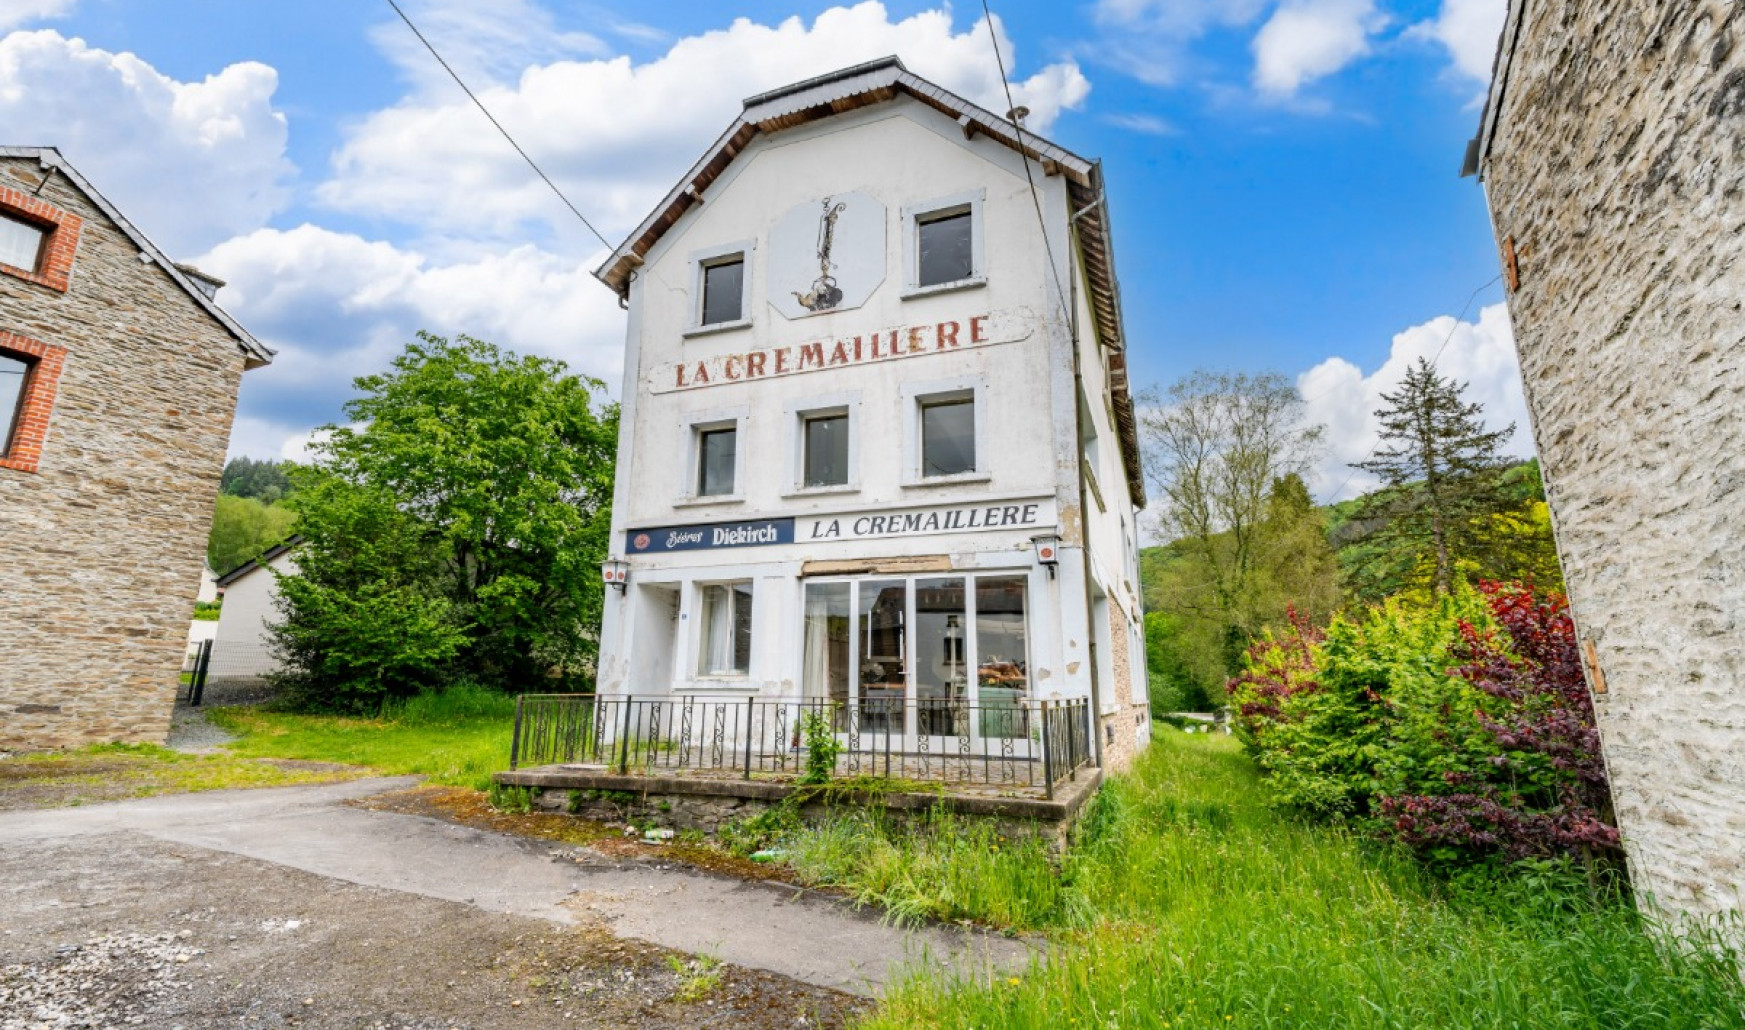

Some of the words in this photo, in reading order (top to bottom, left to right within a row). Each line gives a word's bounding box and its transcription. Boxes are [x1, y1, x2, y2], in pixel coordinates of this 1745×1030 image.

[675, 360, 710, 388] LA
[724, 314, 990, 381] CREMAILLERE
[712, 523, 778, 545] Diekirch
[810, 519, 841, 539] LA
[853, 504, 1039, 536] CREMAILLERE
